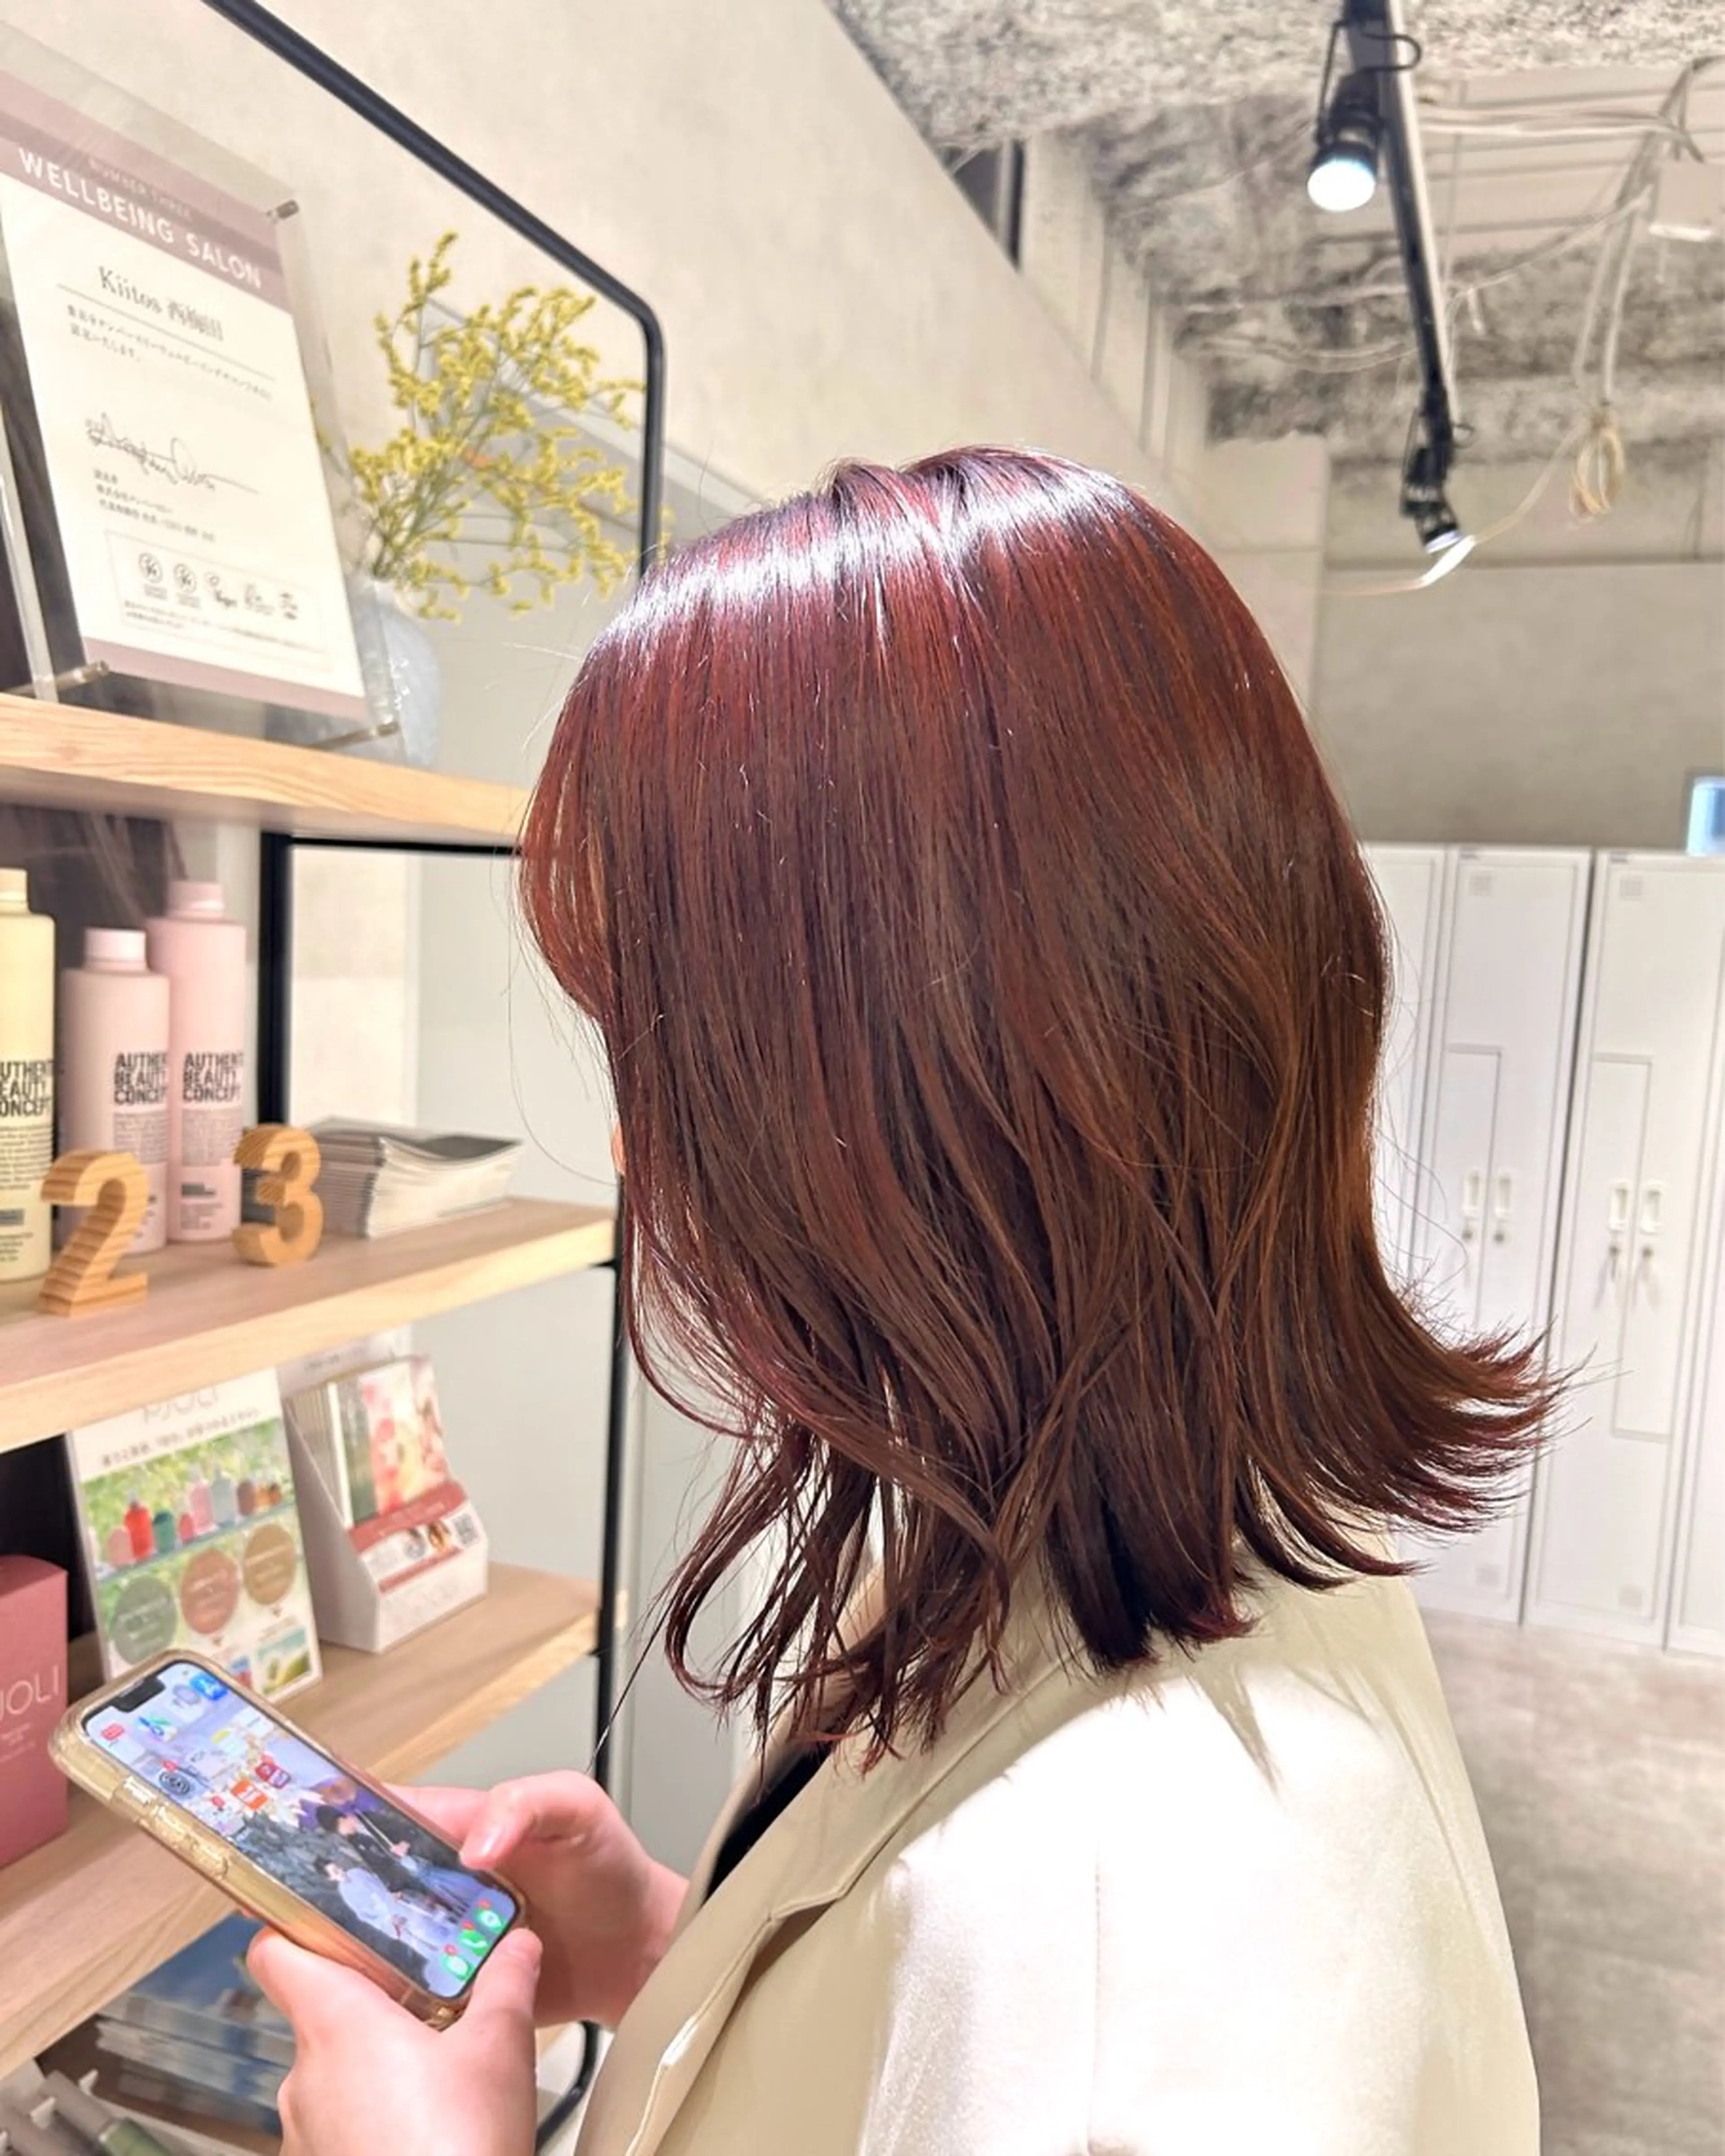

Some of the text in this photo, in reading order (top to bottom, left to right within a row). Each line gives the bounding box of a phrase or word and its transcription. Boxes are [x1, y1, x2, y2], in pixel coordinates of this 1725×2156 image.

[18, 147, 261, 288] WELLBEING SALON
[39, 1147, 149, 1319] 2
[231, 1123, 324, 1268] 3
